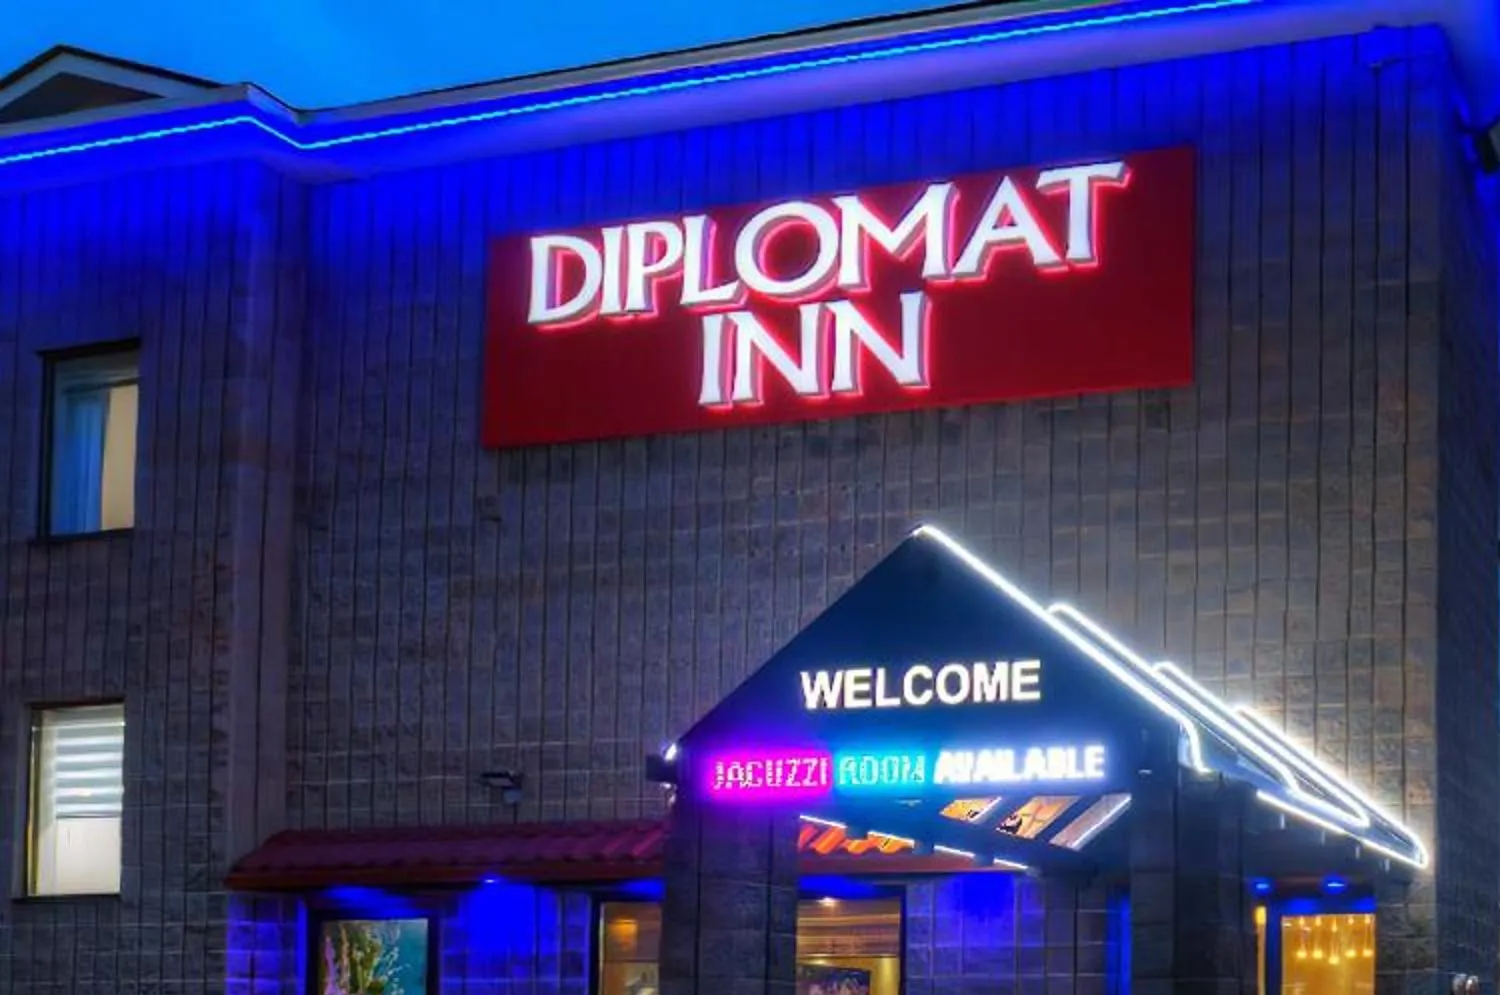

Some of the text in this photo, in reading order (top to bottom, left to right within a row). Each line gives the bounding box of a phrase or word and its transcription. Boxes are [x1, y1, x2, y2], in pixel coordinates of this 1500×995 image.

[526, 160, 1134, 328] DIPLOMAT
[698, 289, 930, 408] INN
[800, 659, 1042, 710] WELCOME
[713, 745, 1105, 790] JACUZZI ROOM AVAILABLE
